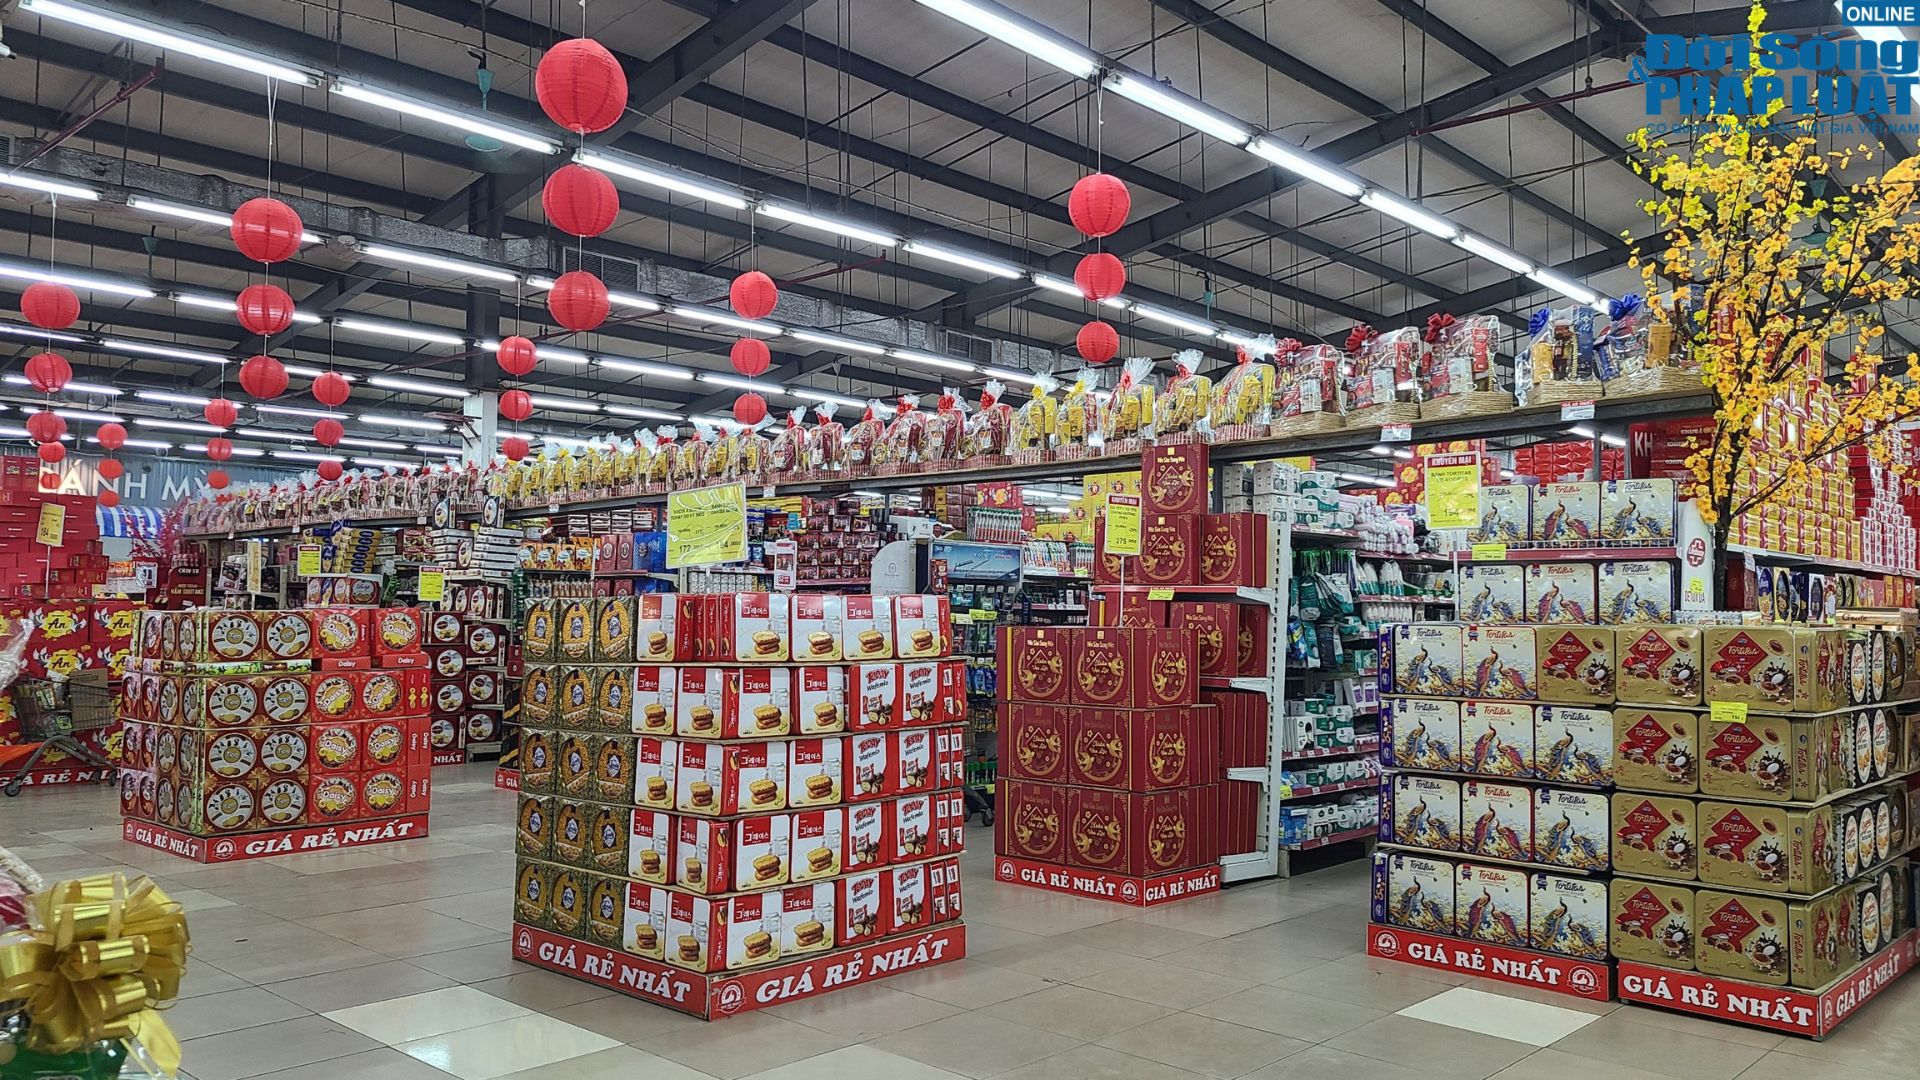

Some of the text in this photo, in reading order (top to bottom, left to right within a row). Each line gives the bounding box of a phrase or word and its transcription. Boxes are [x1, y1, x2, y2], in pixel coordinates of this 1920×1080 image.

[1432, 457, 1457, 466] KHUYẾN
[328, 622, 347, 643] Daisy
[387, 624, 410, 638] Daisy
[338, 660, 355, 668] Daisy
[866, 668, 889, 684] TODAY
[909, 667, 932, 681] TODAY
[324, 686, 346, 706] Daisy
[372, 686, 392, 704] Daisy
[324, 740, 348, 754] Daisy
[374, 738, 396, 750] Daisy
[858, 737, 881, 752] TODAY
[904, 732, 924, 747] TODAY
[434, 752, 462, 763] NHẤT
[322, 790, 346, 800] Daisy
[371, 787, 394, 796] Daisy
[854, 807, 876, 824] TODAY
[902, 800, 924, 816] TODAY
[136, 828, 198, 858] GIÁ RẺ NHẤT
[245, 819, 413, 855] GIÁ RẺ NHẤT
[898, 868, 919, 885] TODAY
[1021, 868, 1046, 883] GIÁ
[1050, 871, 1069, 887] RẺ
[1073, 876, 1116, 896] NHẤT
[851, 878, 874, 895] TODAY
[1145, 884, 1165, 901] GIÁ
[1170, 877, 1185, 895] RẺ
[1187, 871, 1217, 892] NHẤT
[539, 940, 577, 969] GIÁ
[582, 952, 613, 982] RẺ
[619, 969, 691, 1004] NHẤT
[756, 965, 814, 1004] GIÁ
[822, 951, 865, 987] RẺ
[869, 934, 949, 976] NHẤT
[1408, 943, 1448, 964] GIÁ
[1454, 949, 1485, 971] RẺ
[1492, 959, 1560, 985] NHẤT
[1836, 949, 1900, 1017] GIÁ RẺ NHẤT
[1623, 976, 1673, 1000] GIÁ
[1682, 983, 1719, 1008] RẺ
[1727, 994, 1812, 1026] NHẤT
